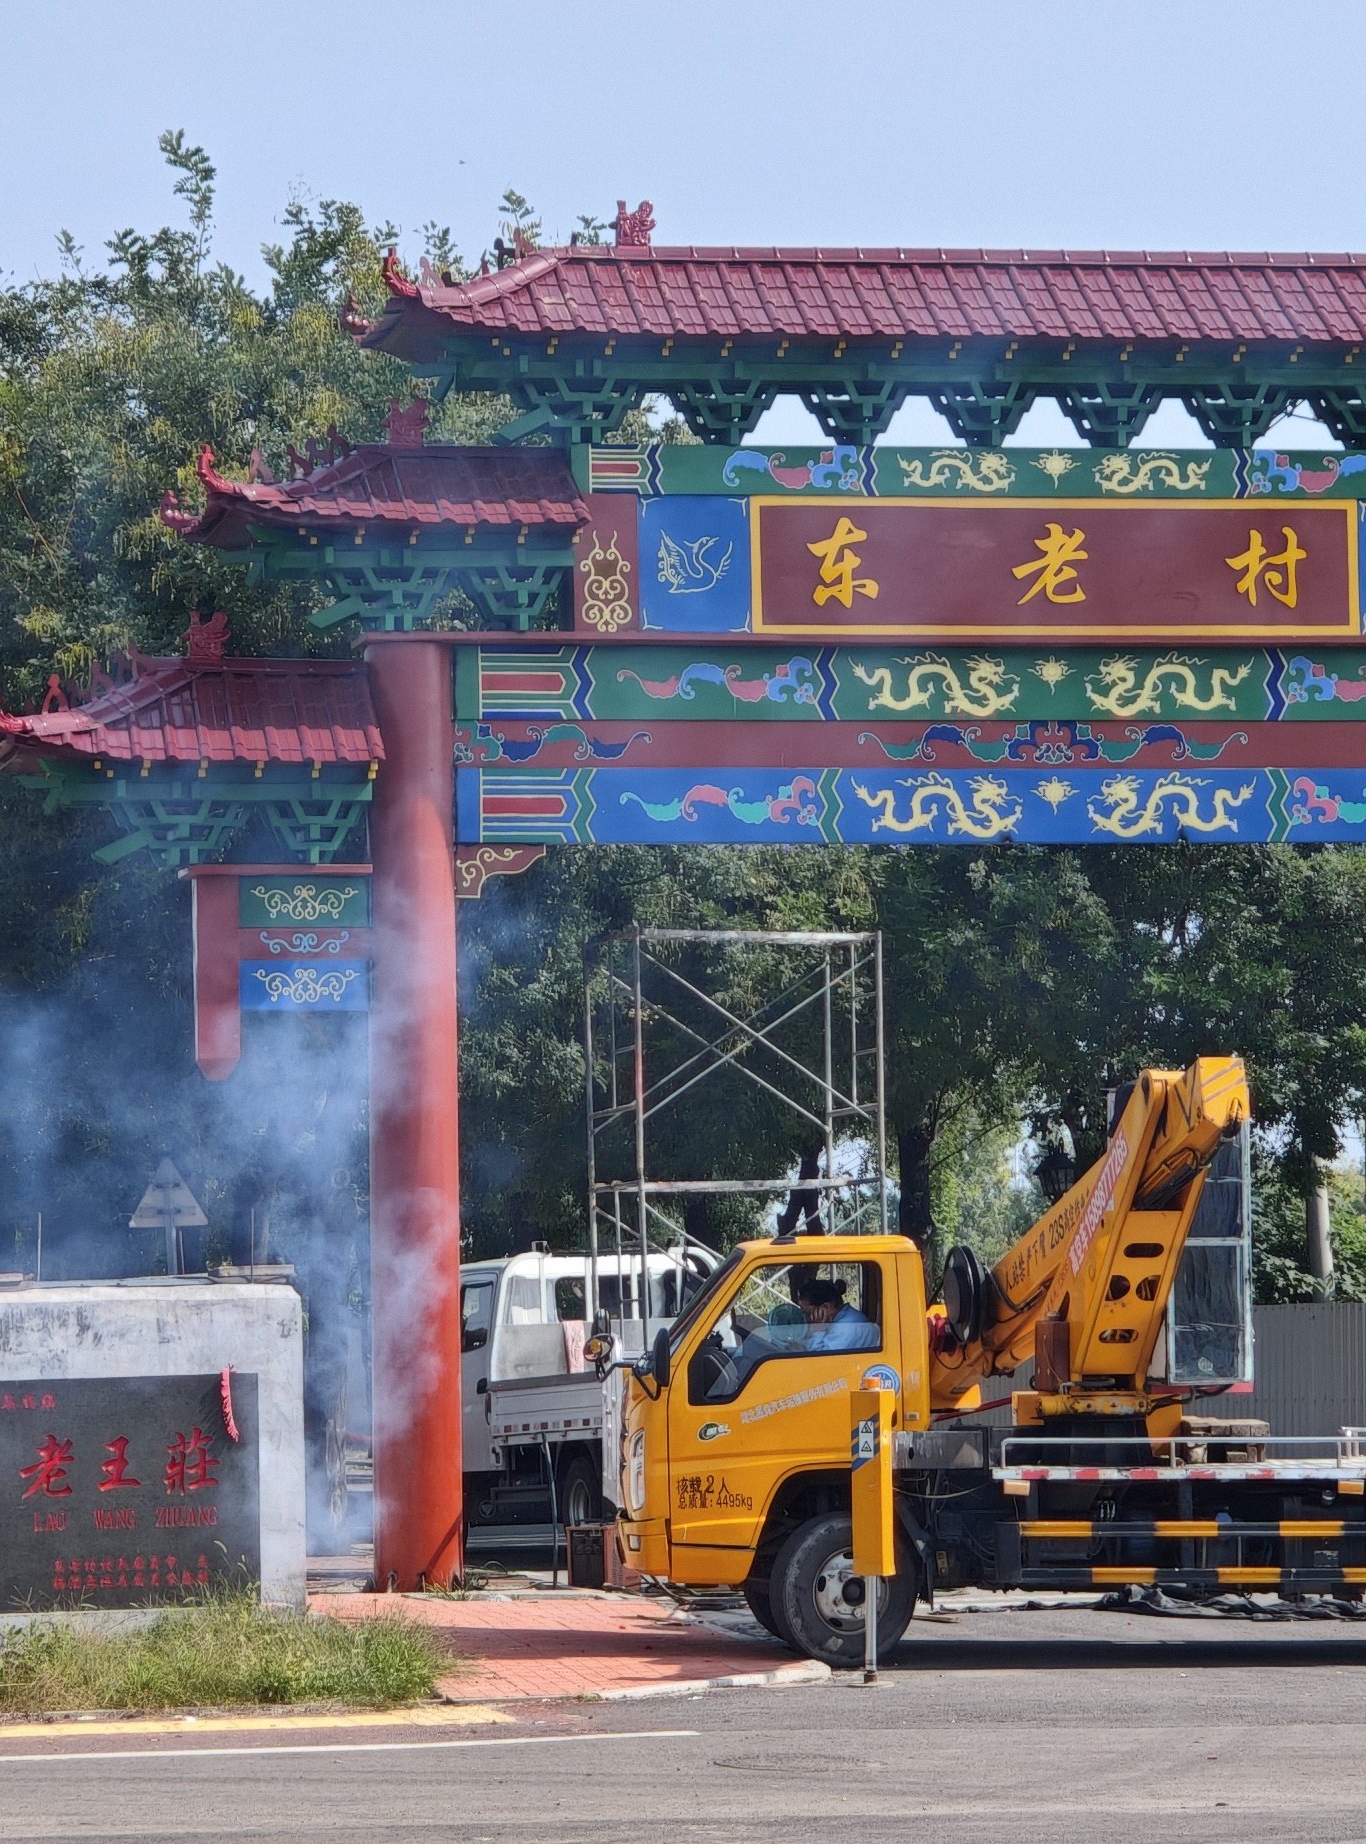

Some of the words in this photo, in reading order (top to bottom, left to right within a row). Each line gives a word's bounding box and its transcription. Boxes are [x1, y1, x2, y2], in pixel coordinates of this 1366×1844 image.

[808, 517, 1308, 608] 东老村
[34, 1512, 67, 1532] LAO
[94, 1508, 136, 1529] WANG
[156, 1506, 218, 1528] ZHUANG
